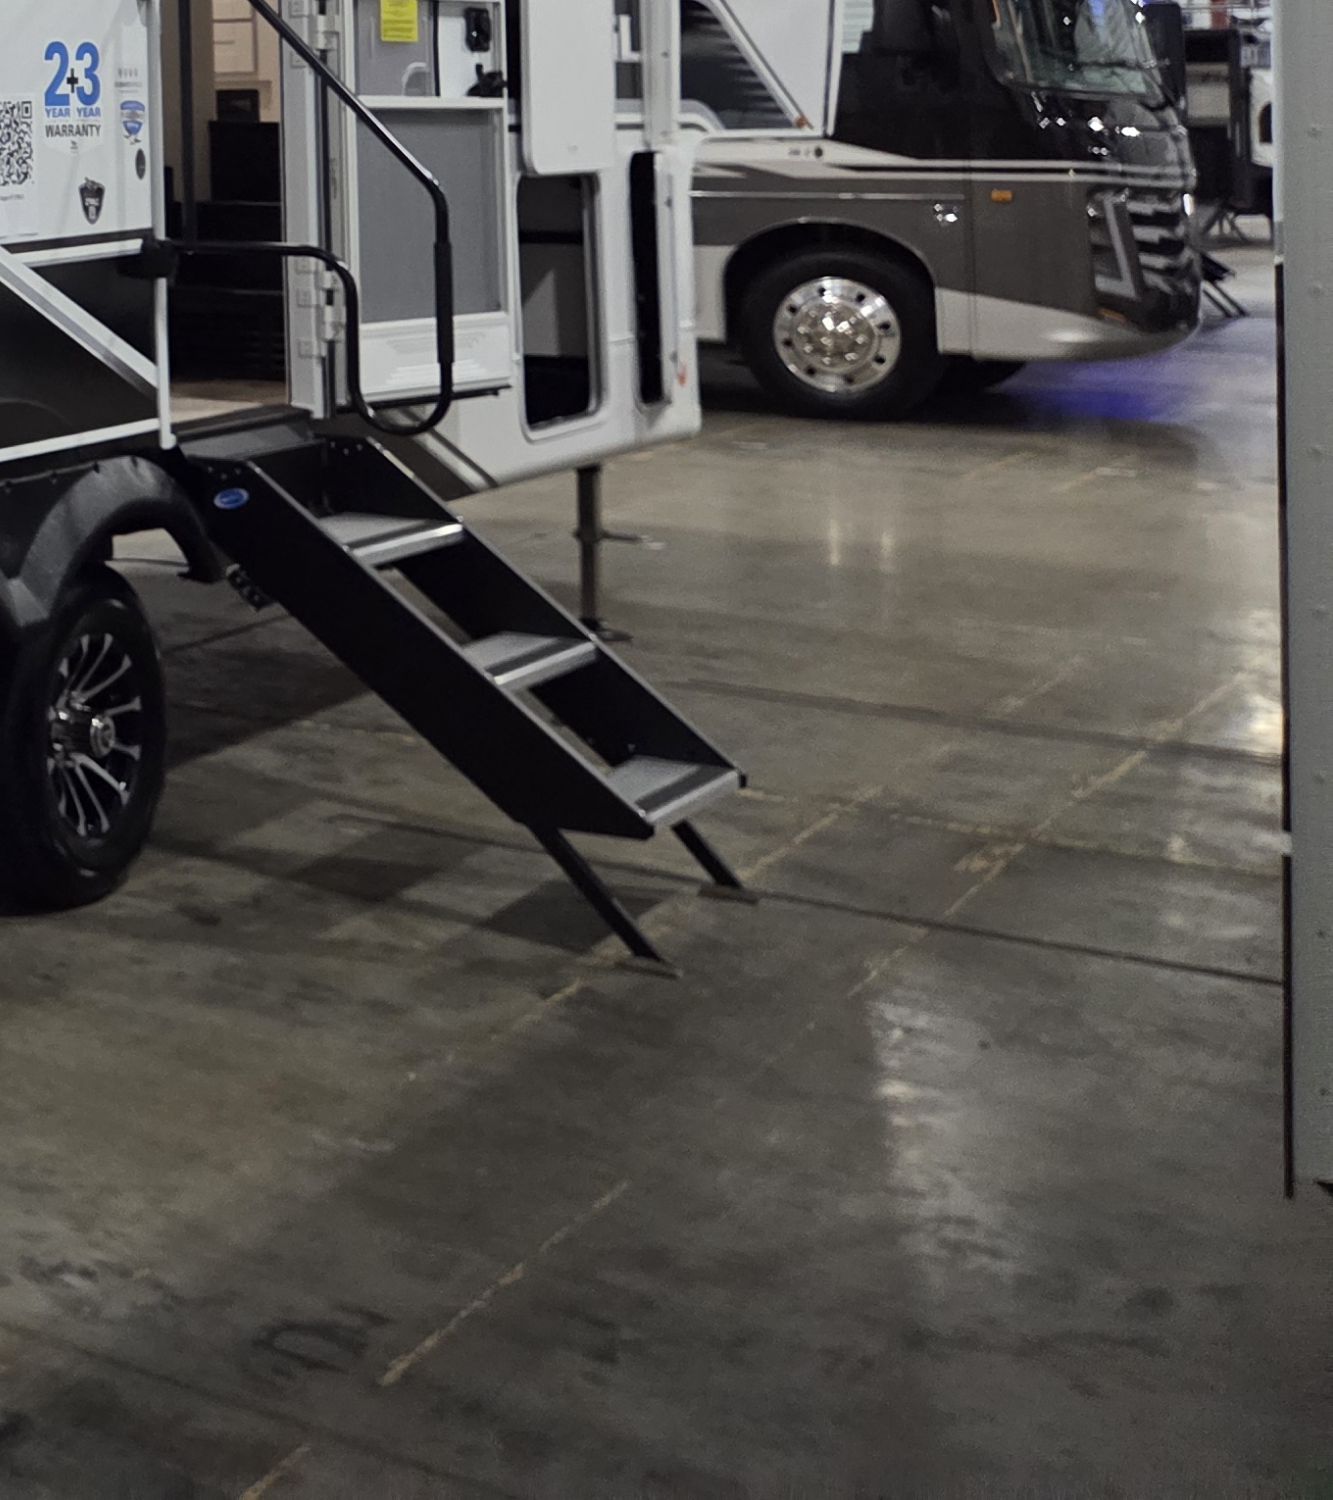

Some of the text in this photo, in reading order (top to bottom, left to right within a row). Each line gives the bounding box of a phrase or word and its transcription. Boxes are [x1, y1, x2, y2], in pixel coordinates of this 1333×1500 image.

[45, 106, 101, 118] YEAR YEAR
[45, 123, 101, 138] WARRANTY
